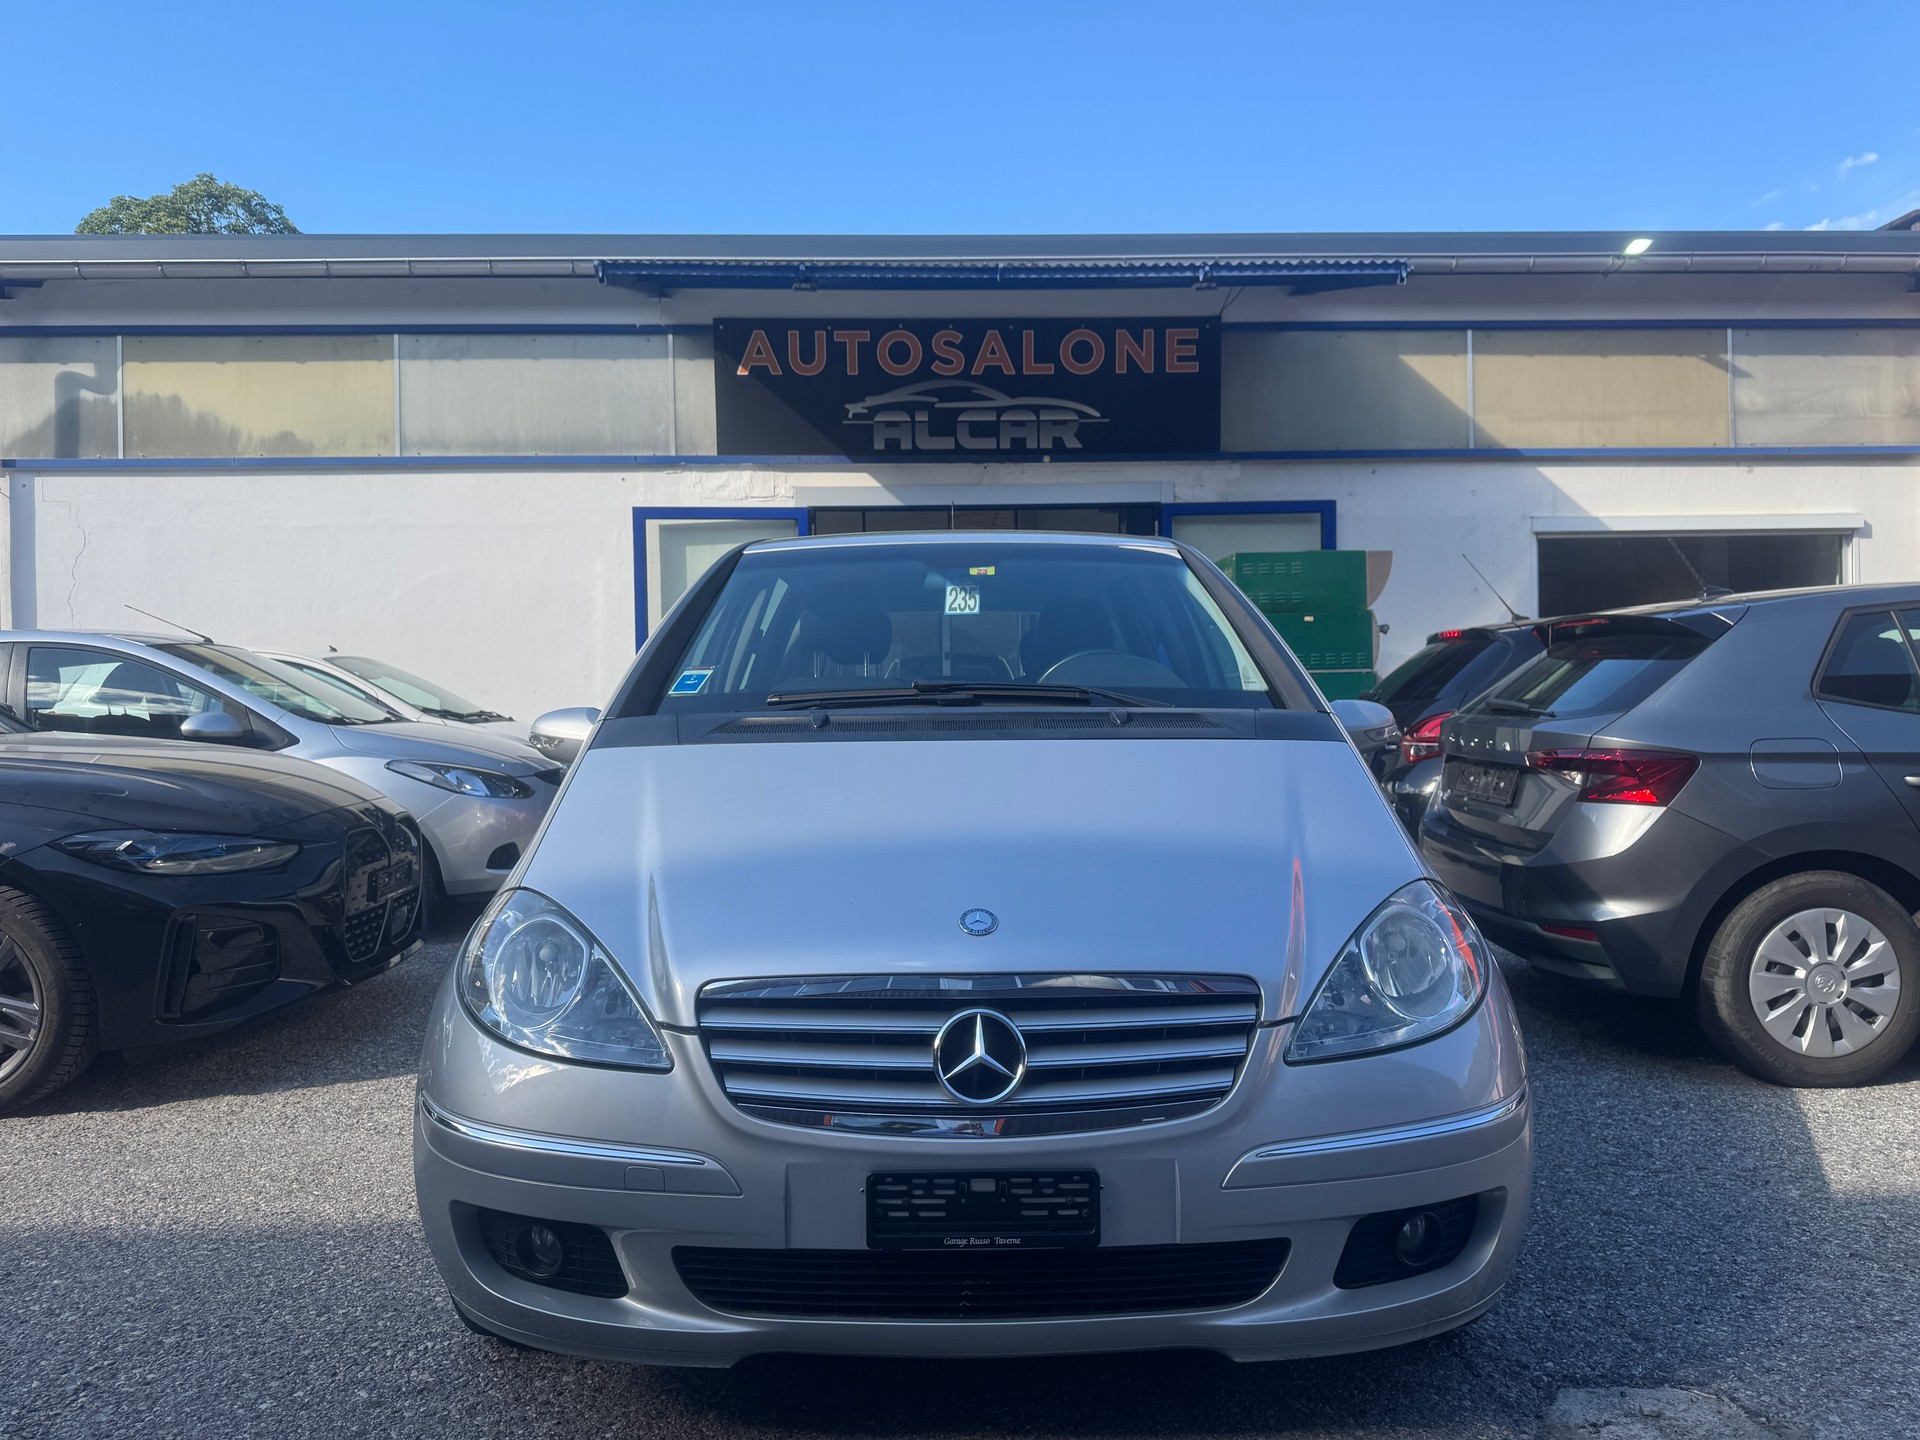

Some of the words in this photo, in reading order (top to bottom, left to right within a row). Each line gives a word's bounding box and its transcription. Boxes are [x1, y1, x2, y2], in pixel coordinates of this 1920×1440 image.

[737, 328, 1200, 377] AUTOSALONE
[873, 409, 1083, 451] ALCAR
[947, 586, 978, 612] 235
[943, 1236, 968, 1248] Garage
[969, 1237, 991, 1245] Russo
[993, 1236, 1021, 1245] Taverne
